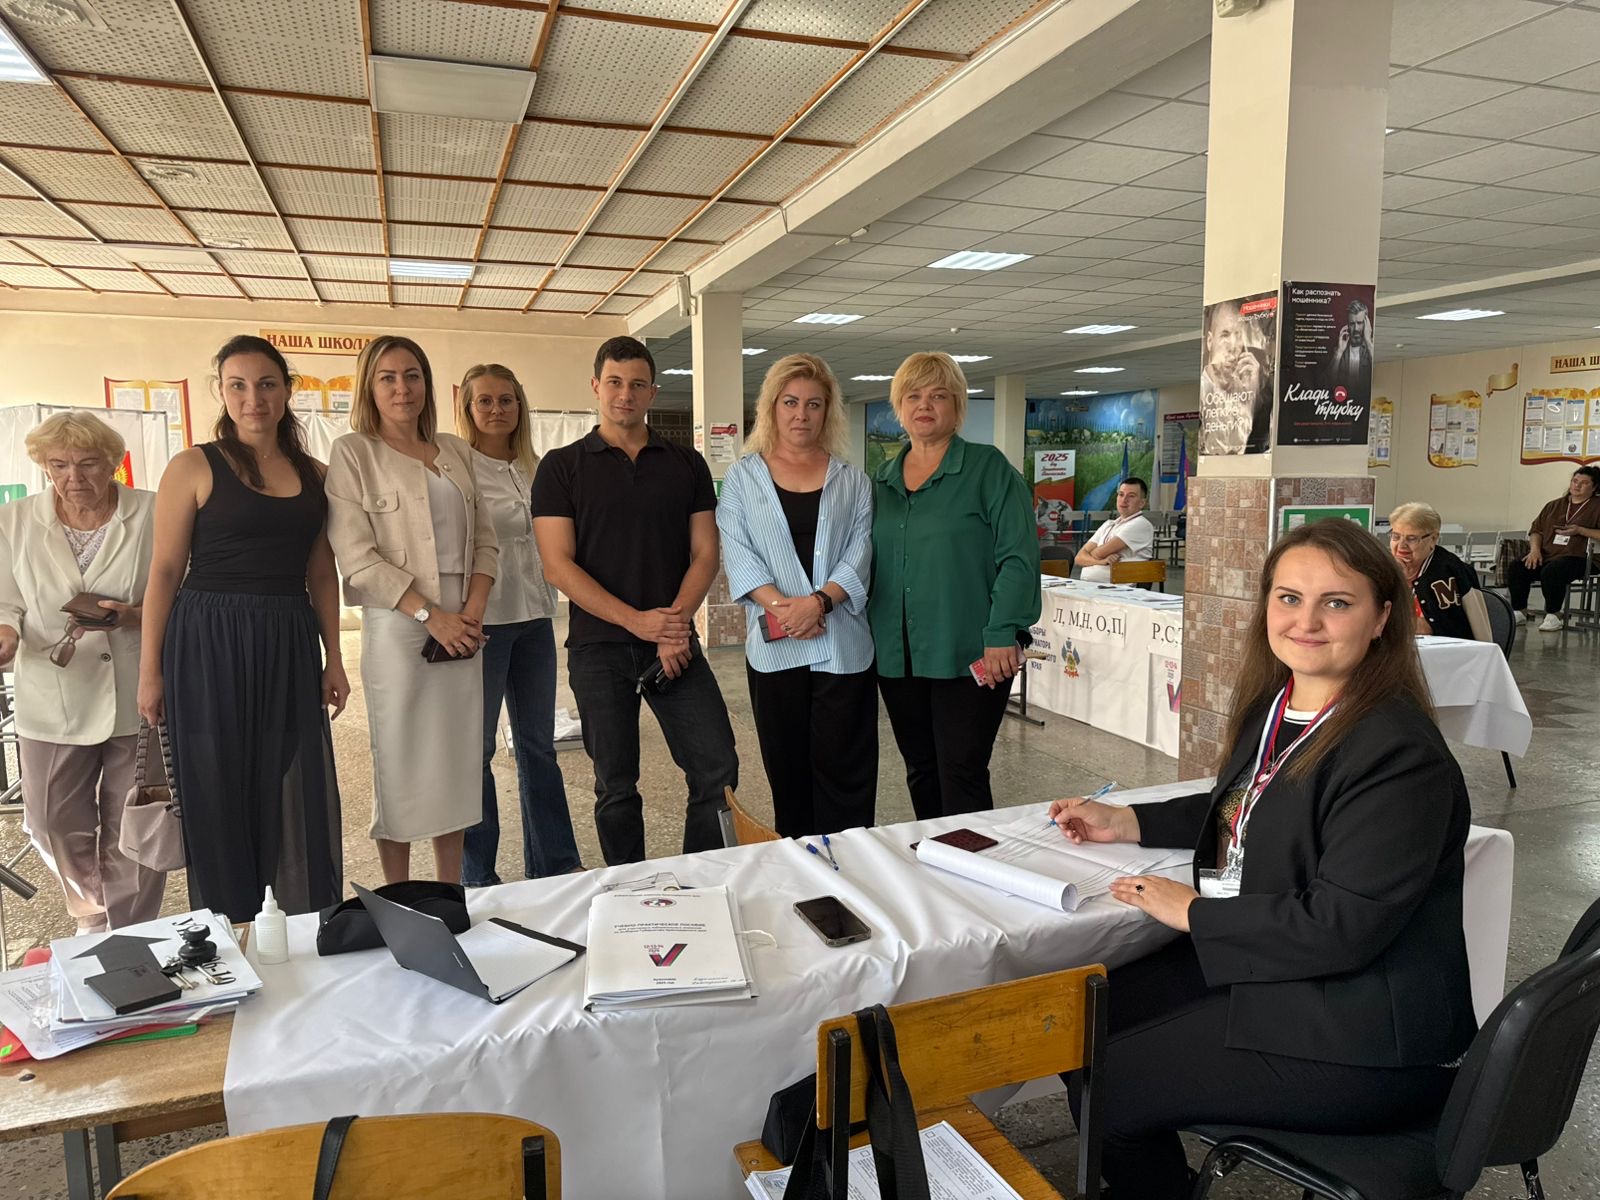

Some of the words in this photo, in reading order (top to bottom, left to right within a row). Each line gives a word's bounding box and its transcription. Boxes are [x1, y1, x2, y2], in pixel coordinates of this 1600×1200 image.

[1291, 288, 1304, 296] Как
[1305, 289, 1341, 297] распознать
[266, 334, 313, 348] НАША
[1554, 357, 1586, 369] НАША
[1284, 382, 1330, 406] Клади
[1315, 399, 1364, 421] трубку
[1041, 453, 1070, 462] 2025
[1431, 577, 1462, 610] M
